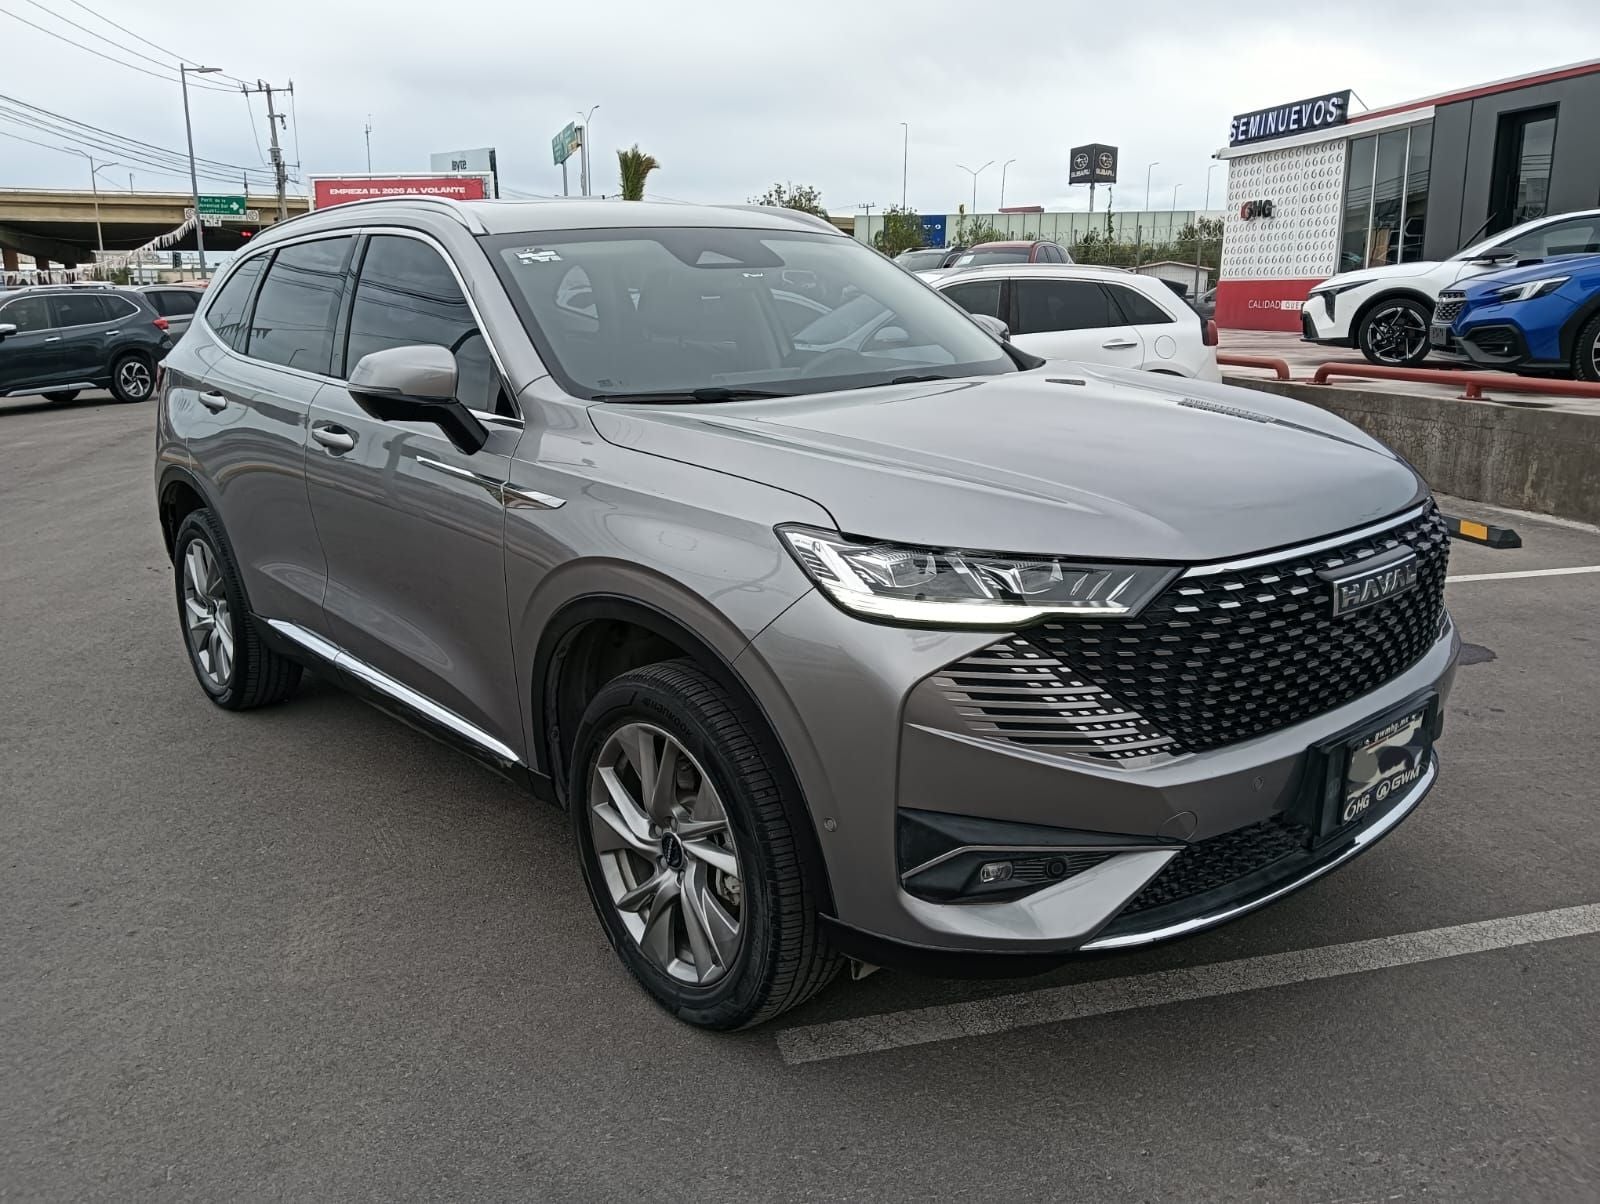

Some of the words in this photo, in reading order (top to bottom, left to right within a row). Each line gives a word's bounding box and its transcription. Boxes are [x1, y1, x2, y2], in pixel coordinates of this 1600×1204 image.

[1229, 97, 1338, 141] SEMINUEVOS
[329, 187, 368, 195] EMPIEZA
[370, 187, 381, 195] EL
[382, 187, 405, 195] 2026
[422, 186, 466, 194] VOLANTE
[1248, 299, 1281, 309] CALIDAD
[1285, 301, 1300, 309] QUE
[1341, 564, 1417, 609] HAVAL
[1391, 765, 1420, 791] GWM
